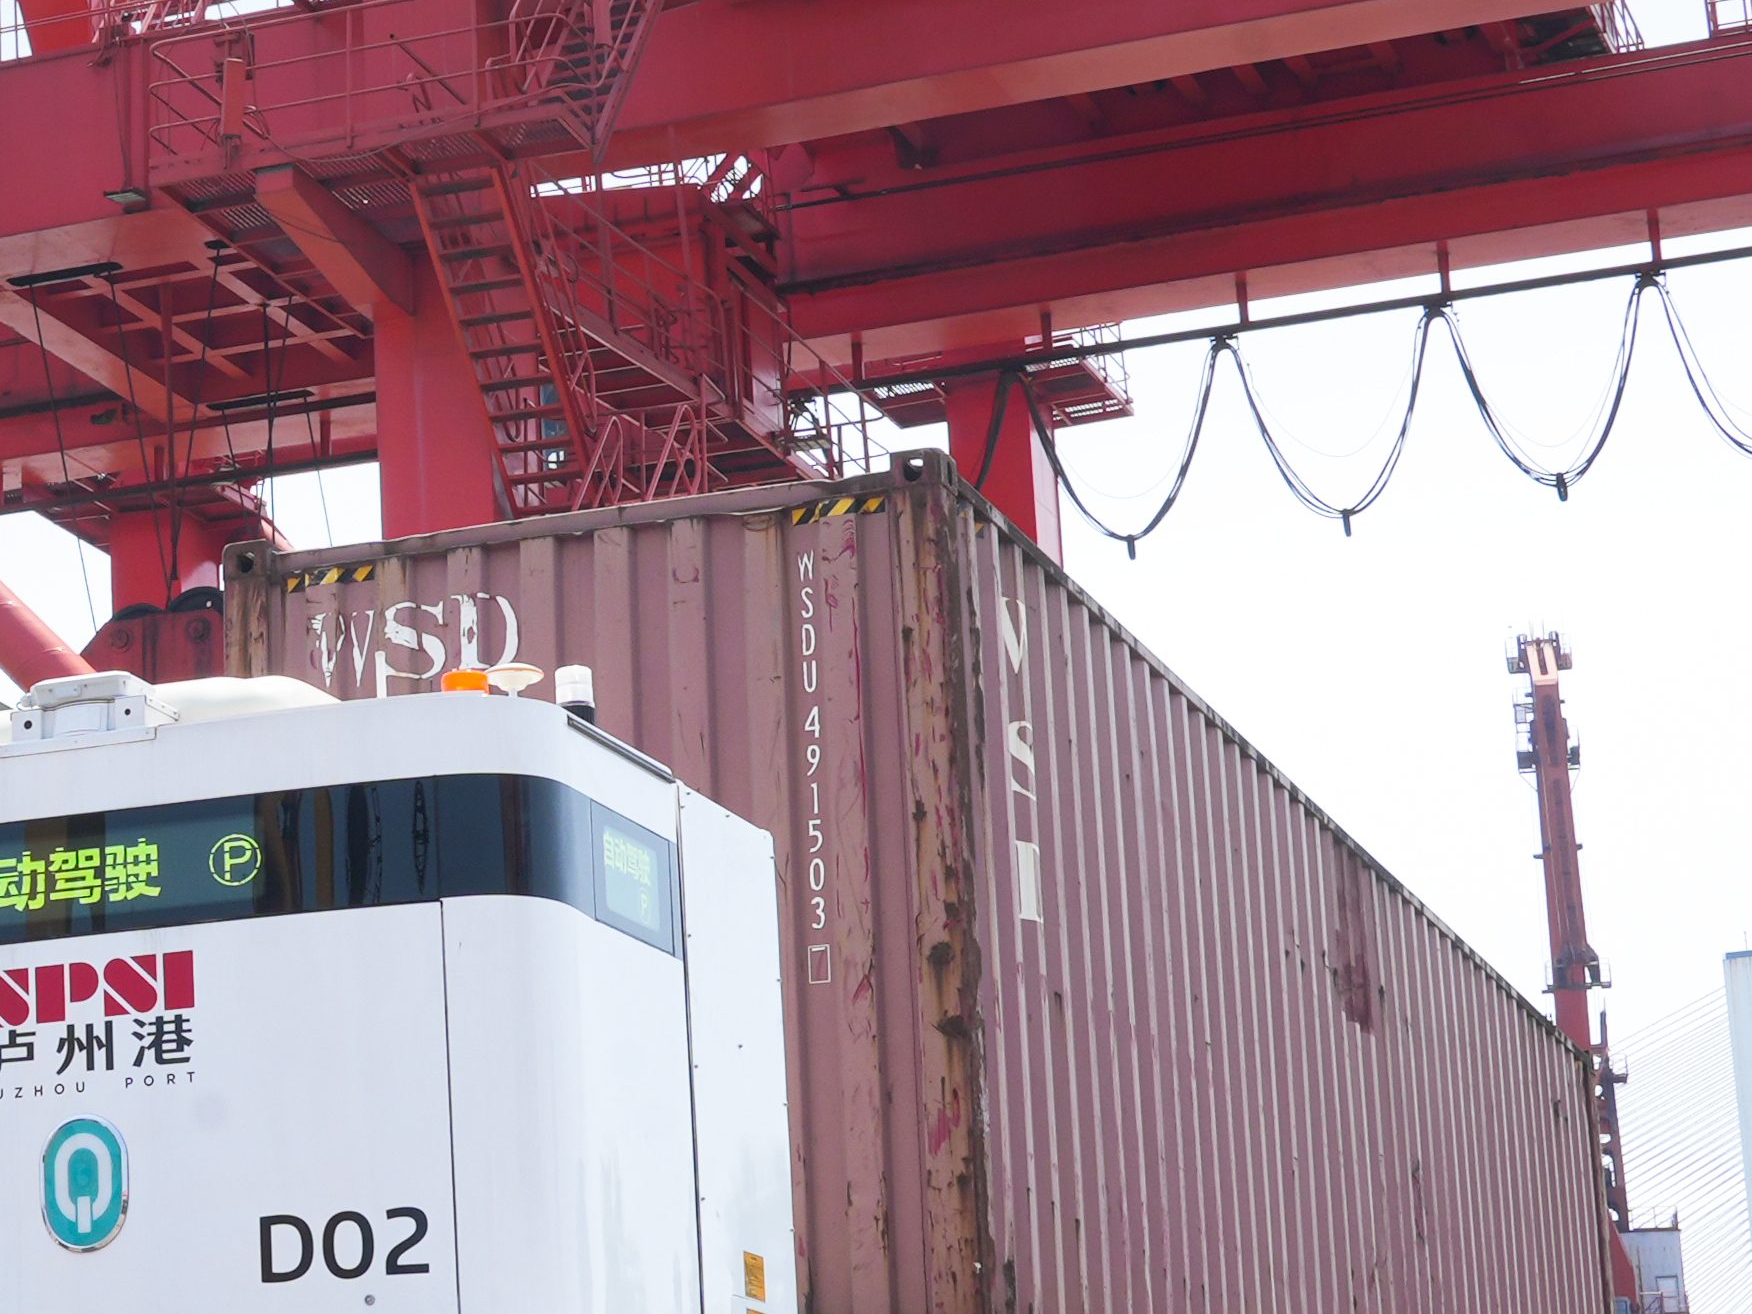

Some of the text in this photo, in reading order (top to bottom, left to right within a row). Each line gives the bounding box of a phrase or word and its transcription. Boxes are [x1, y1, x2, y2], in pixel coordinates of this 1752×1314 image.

[310, 591, 519, 688] WSD
[797, 549, 817, 693] WSDU
[804, 706, 827, 930] 491503
[125, 1071, 195, 1089] PORT
[259, 1206, 431, 1284] D02
